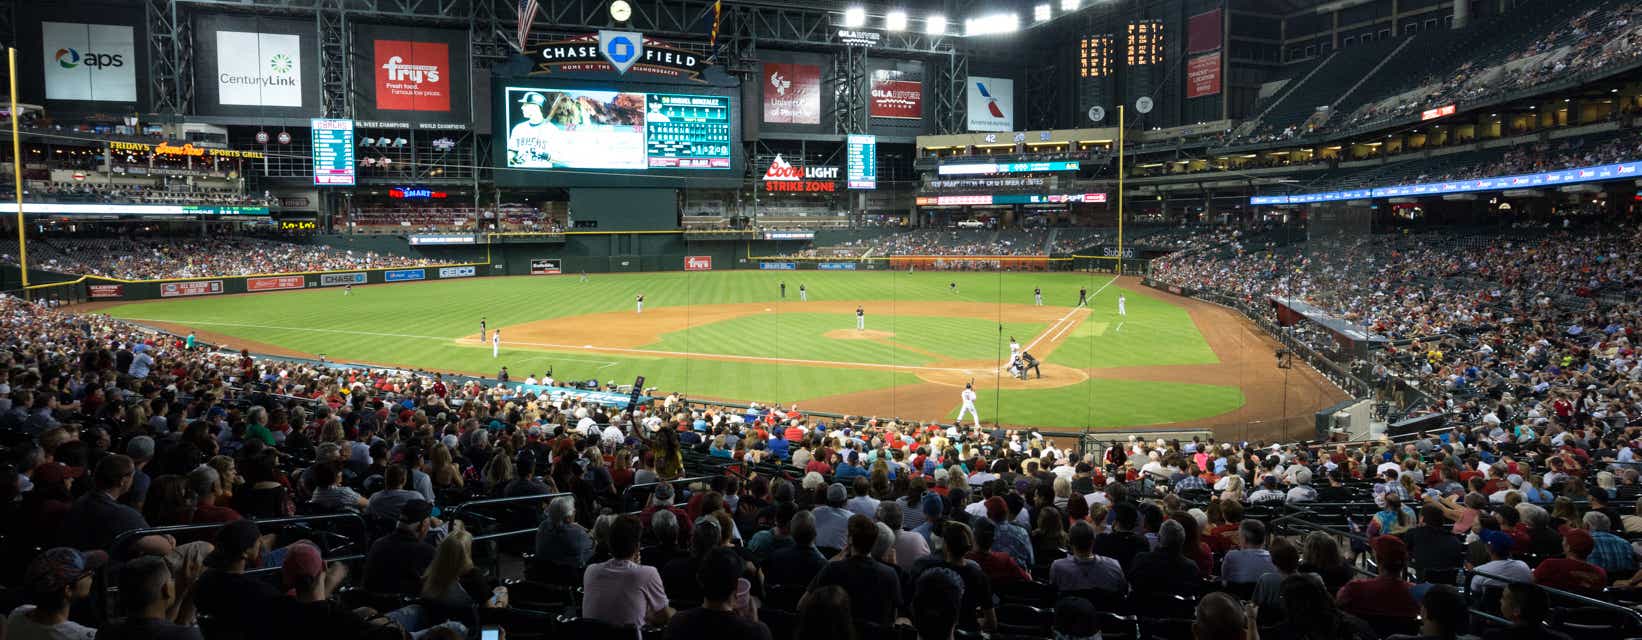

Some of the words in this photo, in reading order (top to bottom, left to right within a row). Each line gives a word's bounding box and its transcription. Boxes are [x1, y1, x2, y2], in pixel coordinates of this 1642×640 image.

[84, 53, 123, 70] aps
[543, 47, 596, 59] CHASE
[647, 50, 696, 67] FIELD
[382, 56, 440, 83] fry's
[632, 66, 679, 76] DIAMONDBACKS
[220, 73, 296, 87] CenturyLink
[871, 89, 892, 98] GILA
[985, 134, 996, 143] 42
[110, 141, 150, 151] FRIDAYS
[209, 148, 240, 157] SPORTS
[767, 161, 804, 177] Coors
[805, 167, 839, 178] LIGHT
[766, 181, 803, 191] STRIKE
[805, 181, 835, 192] ZONE
[1103, 248, 1133, 257] Stubub
